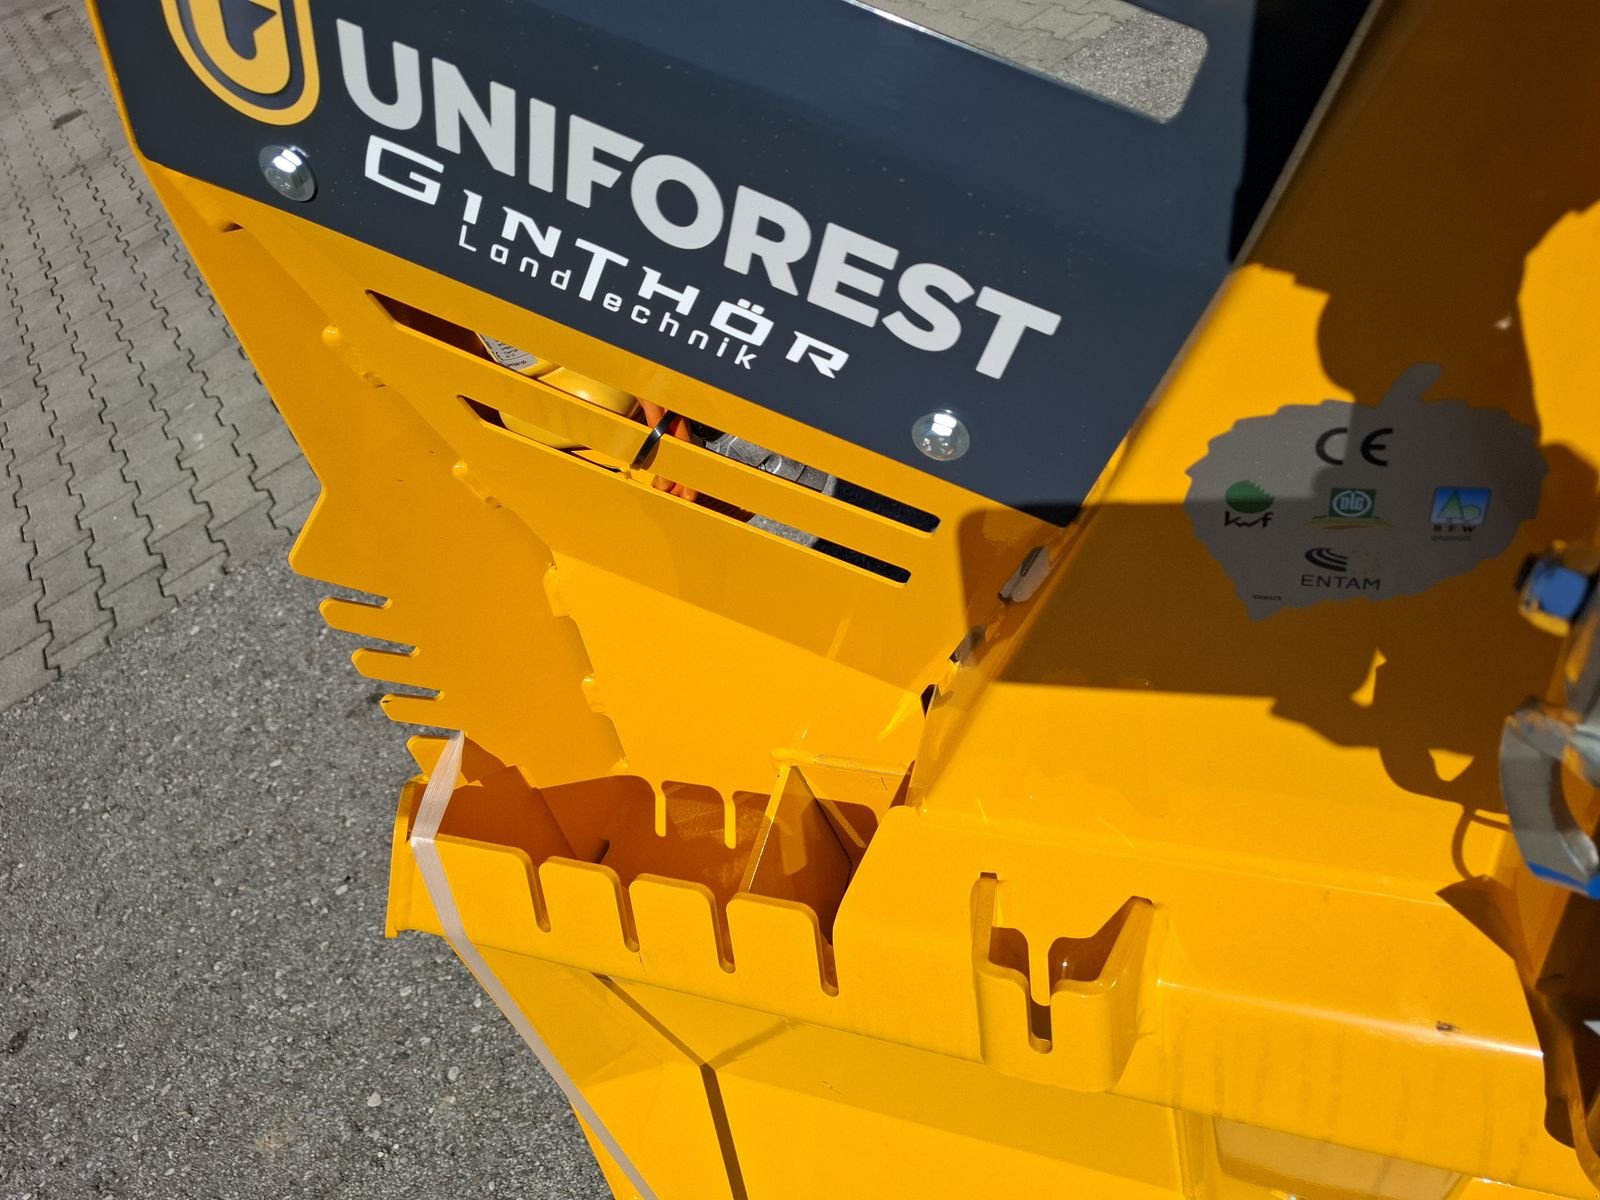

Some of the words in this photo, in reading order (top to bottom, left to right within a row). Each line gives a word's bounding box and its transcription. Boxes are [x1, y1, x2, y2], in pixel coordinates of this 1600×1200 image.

[336, 18, 1062, 380] UNIFOREST
[1315, 427, 1393, 467] CE
[1300, 574, 1381, 591] ENTAM
